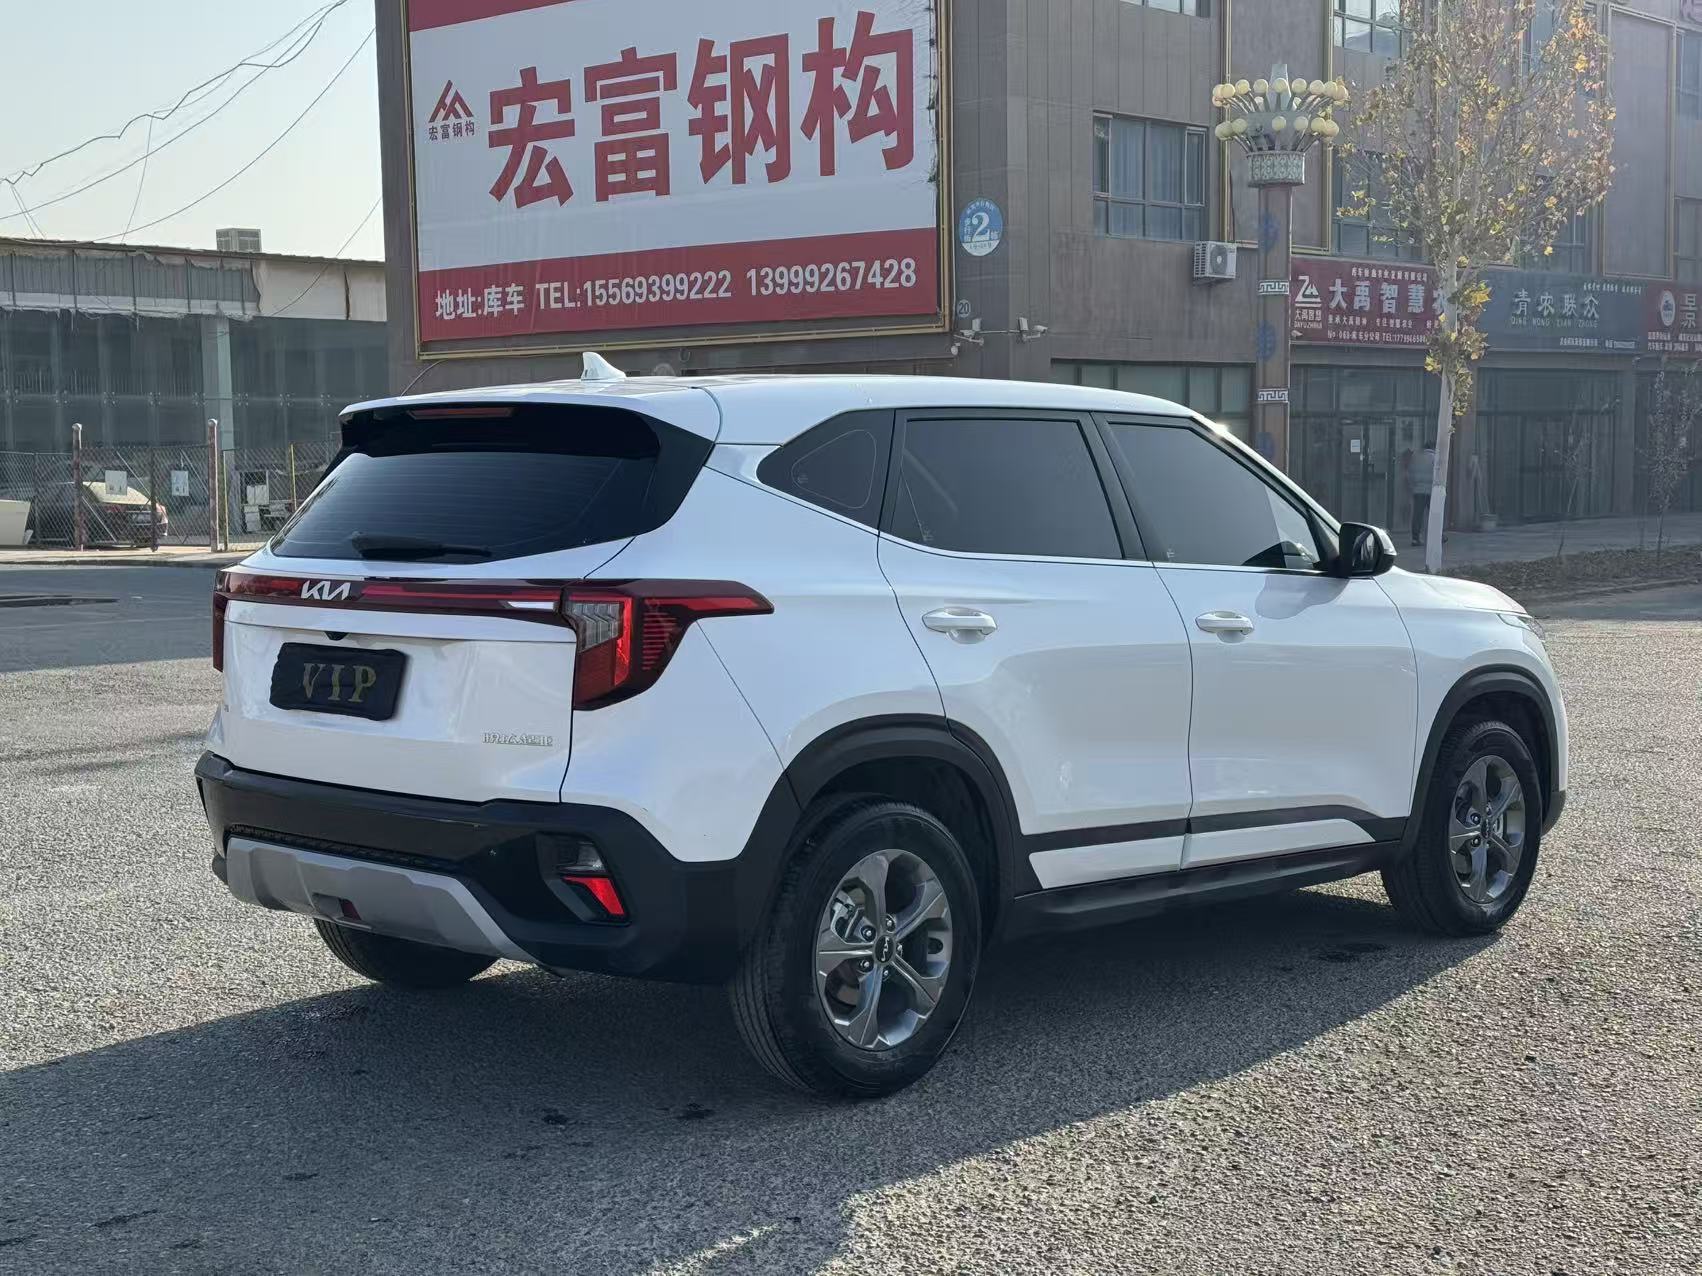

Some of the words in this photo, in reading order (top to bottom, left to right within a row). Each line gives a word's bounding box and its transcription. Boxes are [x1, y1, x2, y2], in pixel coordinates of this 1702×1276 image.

[488, 11, 914, 208] 宏富钢构
[428, 121, 475, 140] 宏富钢构
[971, 212, 989, 241] 2
[435, 282, 525, 320] 地址:库车
[536, 270, 732, 309] TEL:15569399222
[746, 258, 917, 296] 13999267428
[300, 579, 351, 601] KIA
[302, 662, 377, 703] VIP
